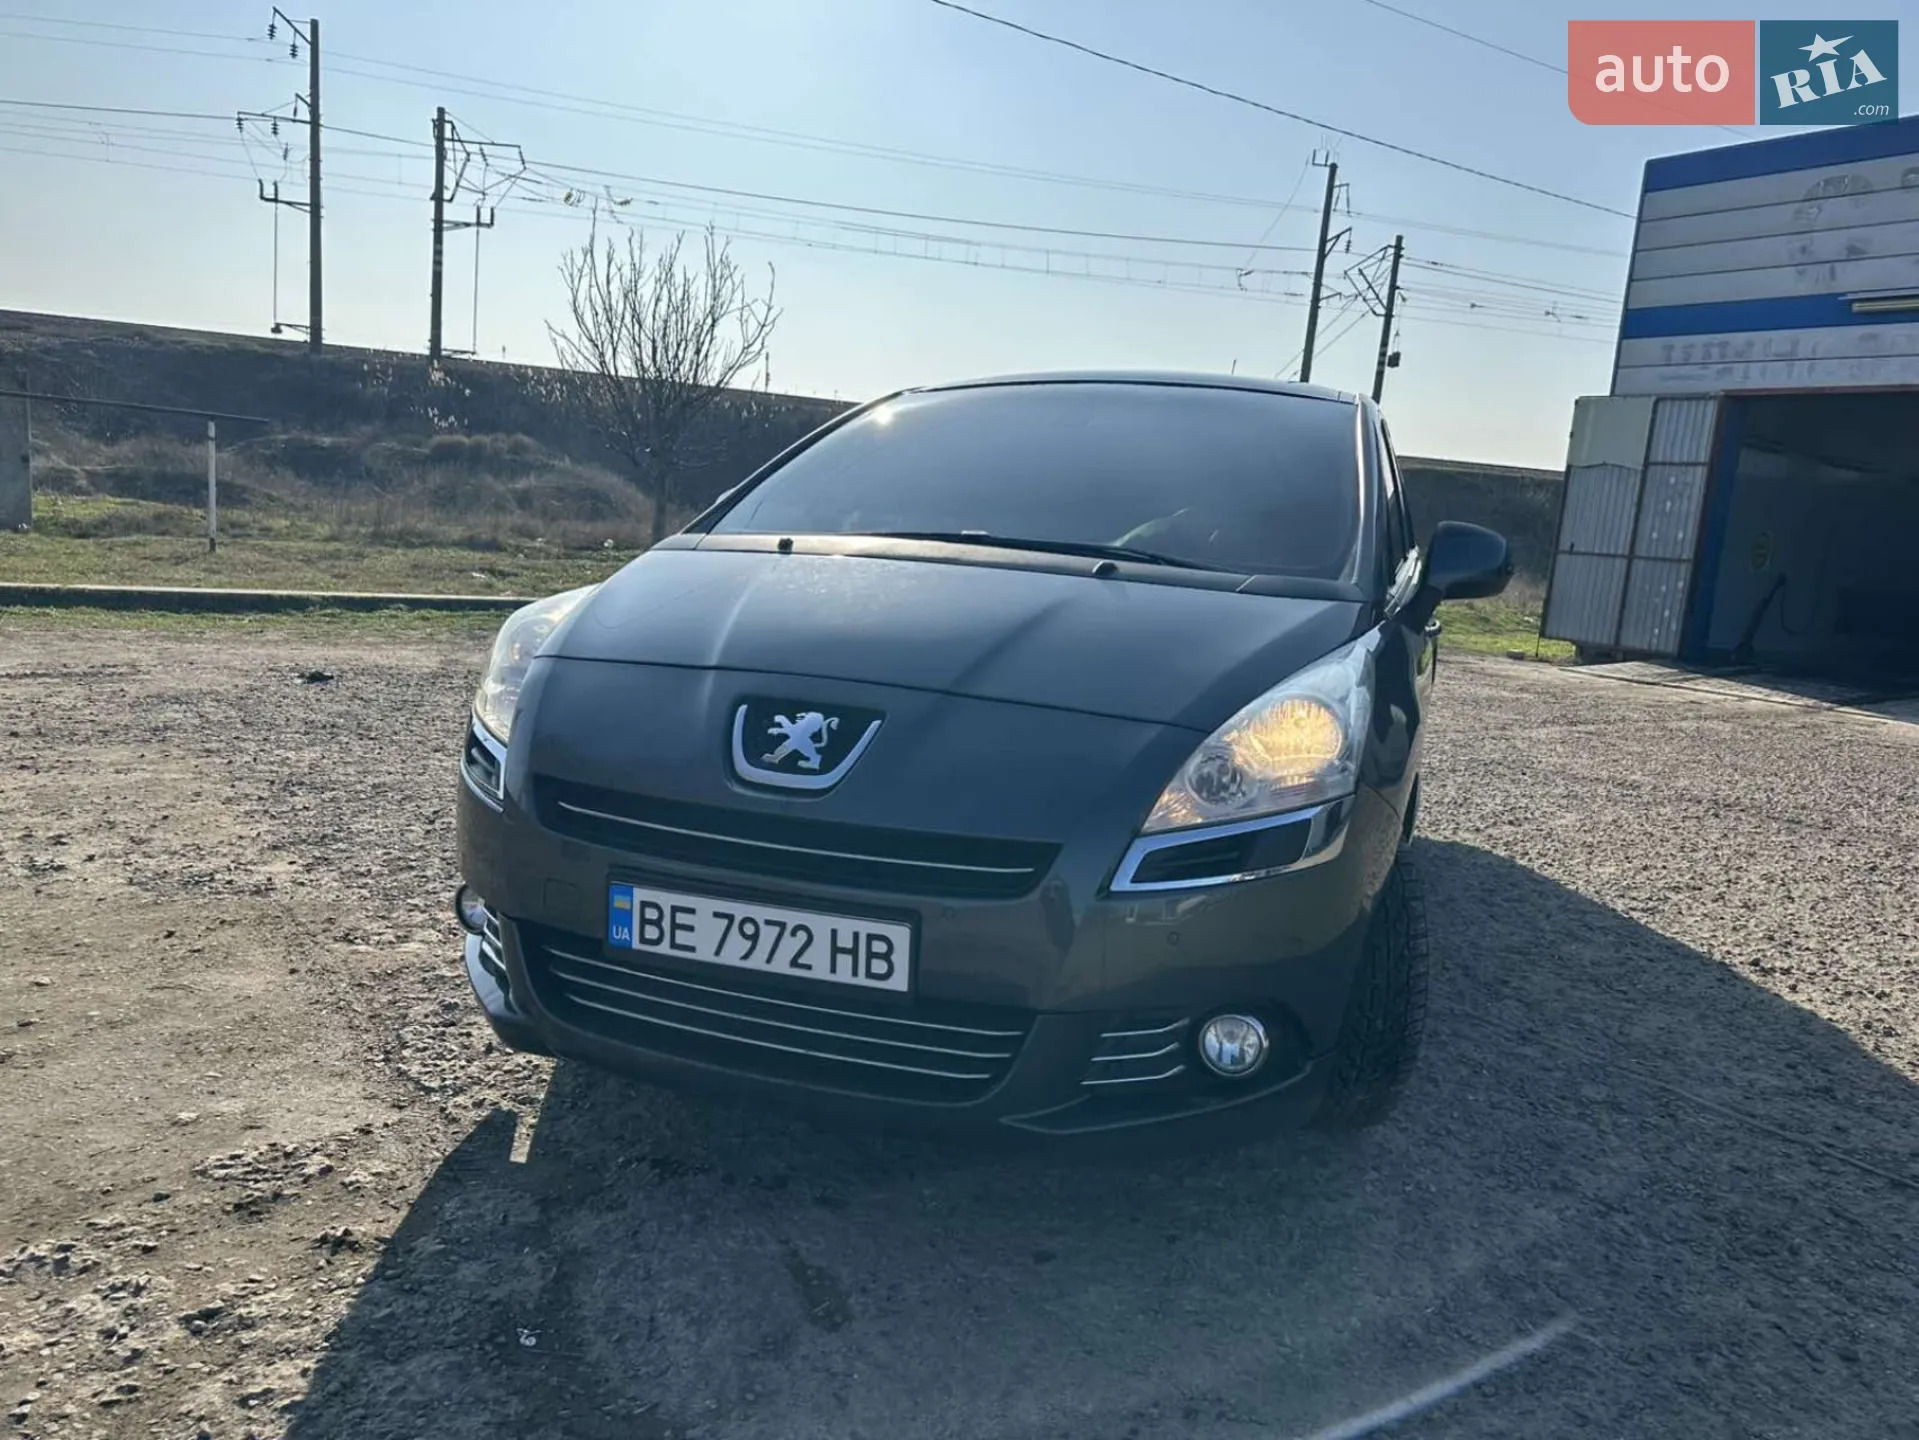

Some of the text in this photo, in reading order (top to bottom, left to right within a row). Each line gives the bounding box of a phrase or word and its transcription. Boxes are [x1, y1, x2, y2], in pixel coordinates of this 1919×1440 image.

[612, 926, 631, 941] UA
[639, 900, 895, 981] BE 7972 HB
